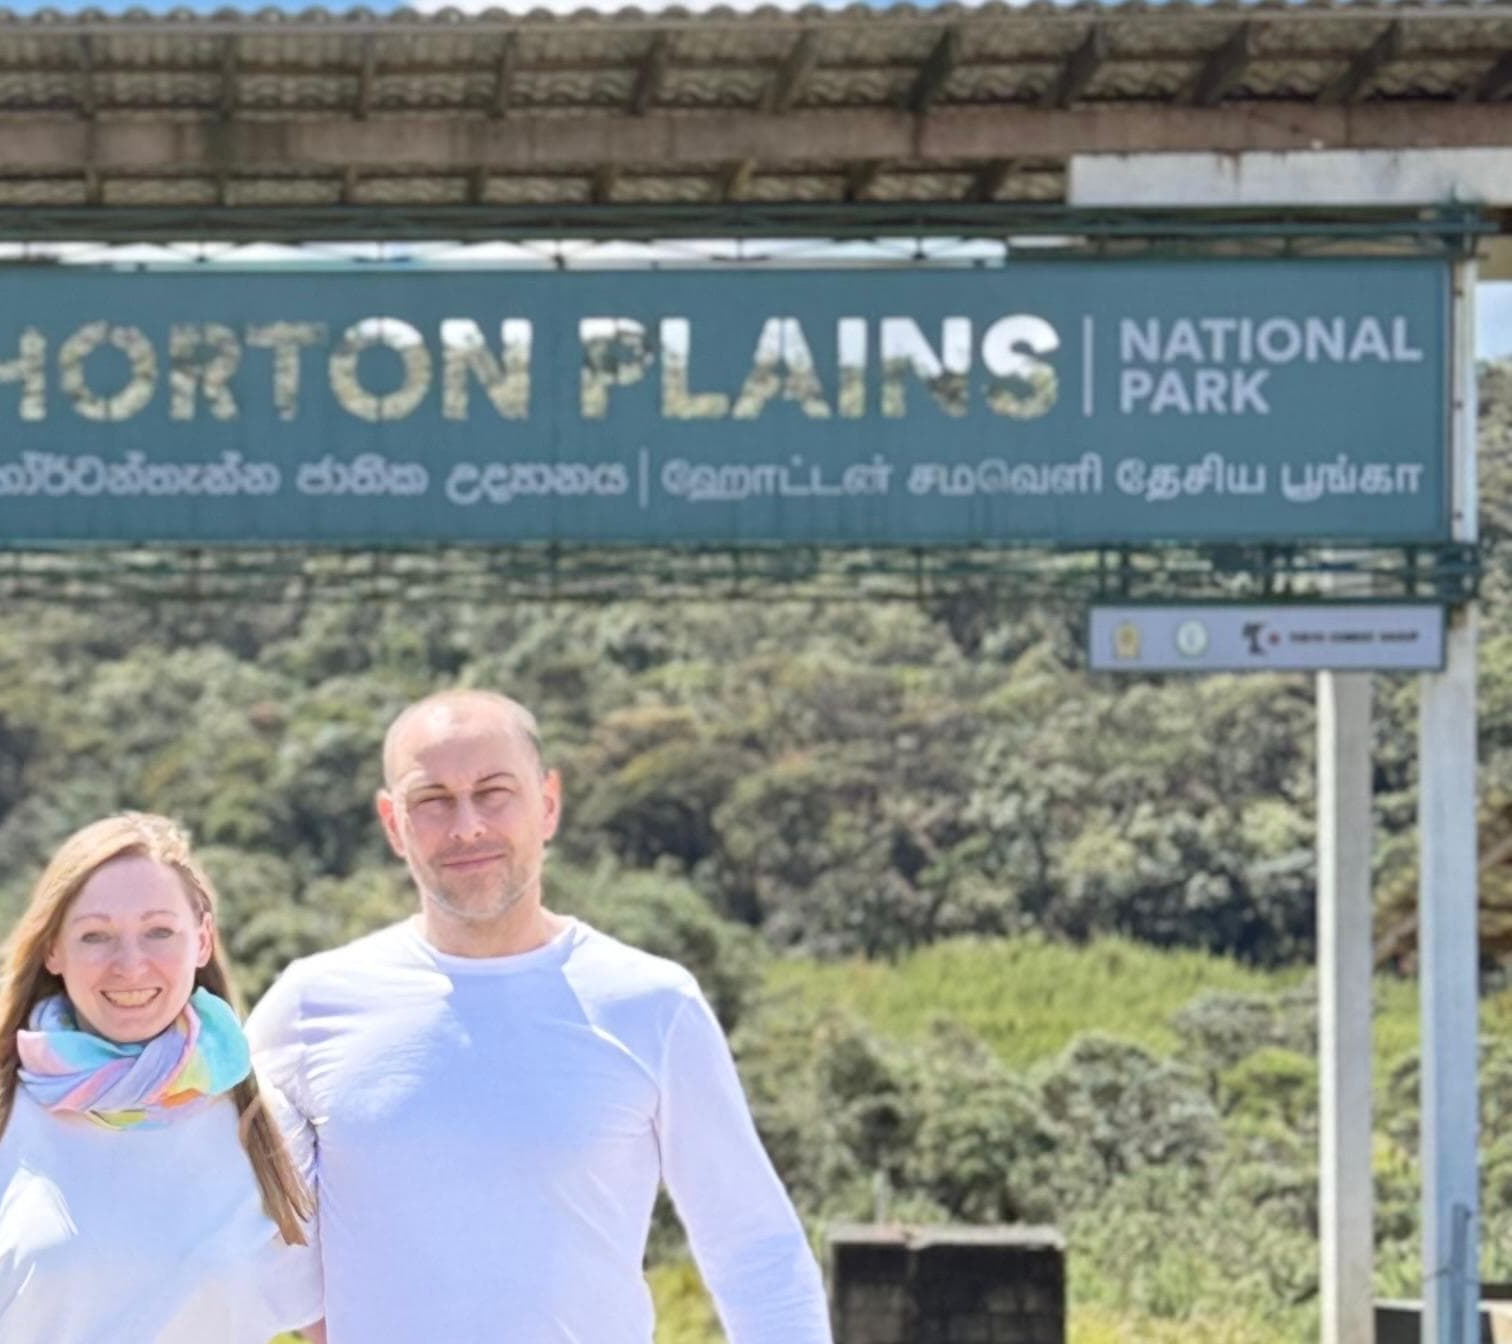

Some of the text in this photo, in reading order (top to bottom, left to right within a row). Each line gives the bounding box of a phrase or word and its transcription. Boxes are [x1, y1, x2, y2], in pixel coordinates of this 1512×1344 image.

[1119, 316, 1424, 363] NATIONAL
[579, 314, 1060, 419] PLAINS
[1120, 367, 1269, 414] PARK
[1115, 452, 1267, 504] தேசிய
